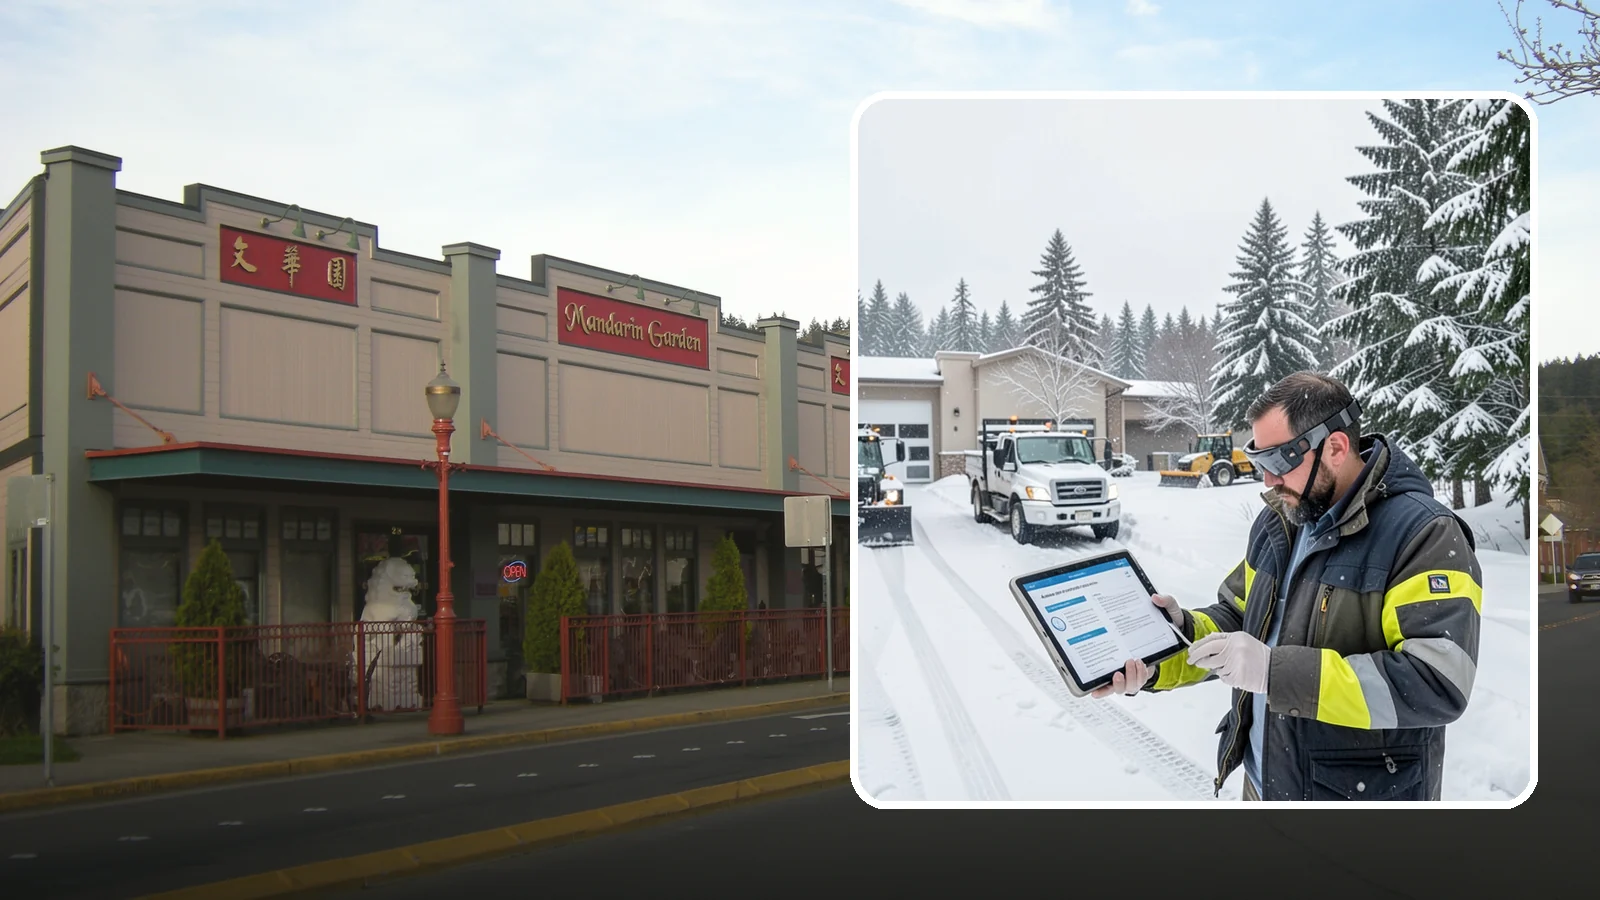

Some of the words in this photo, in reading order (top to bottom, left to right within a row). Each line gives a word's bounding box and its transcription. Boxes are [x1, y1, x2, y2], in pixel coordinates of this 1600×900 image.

[231, 235, 347, 291] 文華園
[564, 302, 644, 341] Mandarin
[648, 320, 702, 352] Garden
[835, 363, 846, 386] 文
[503, 565, 527, 578] OPEN
